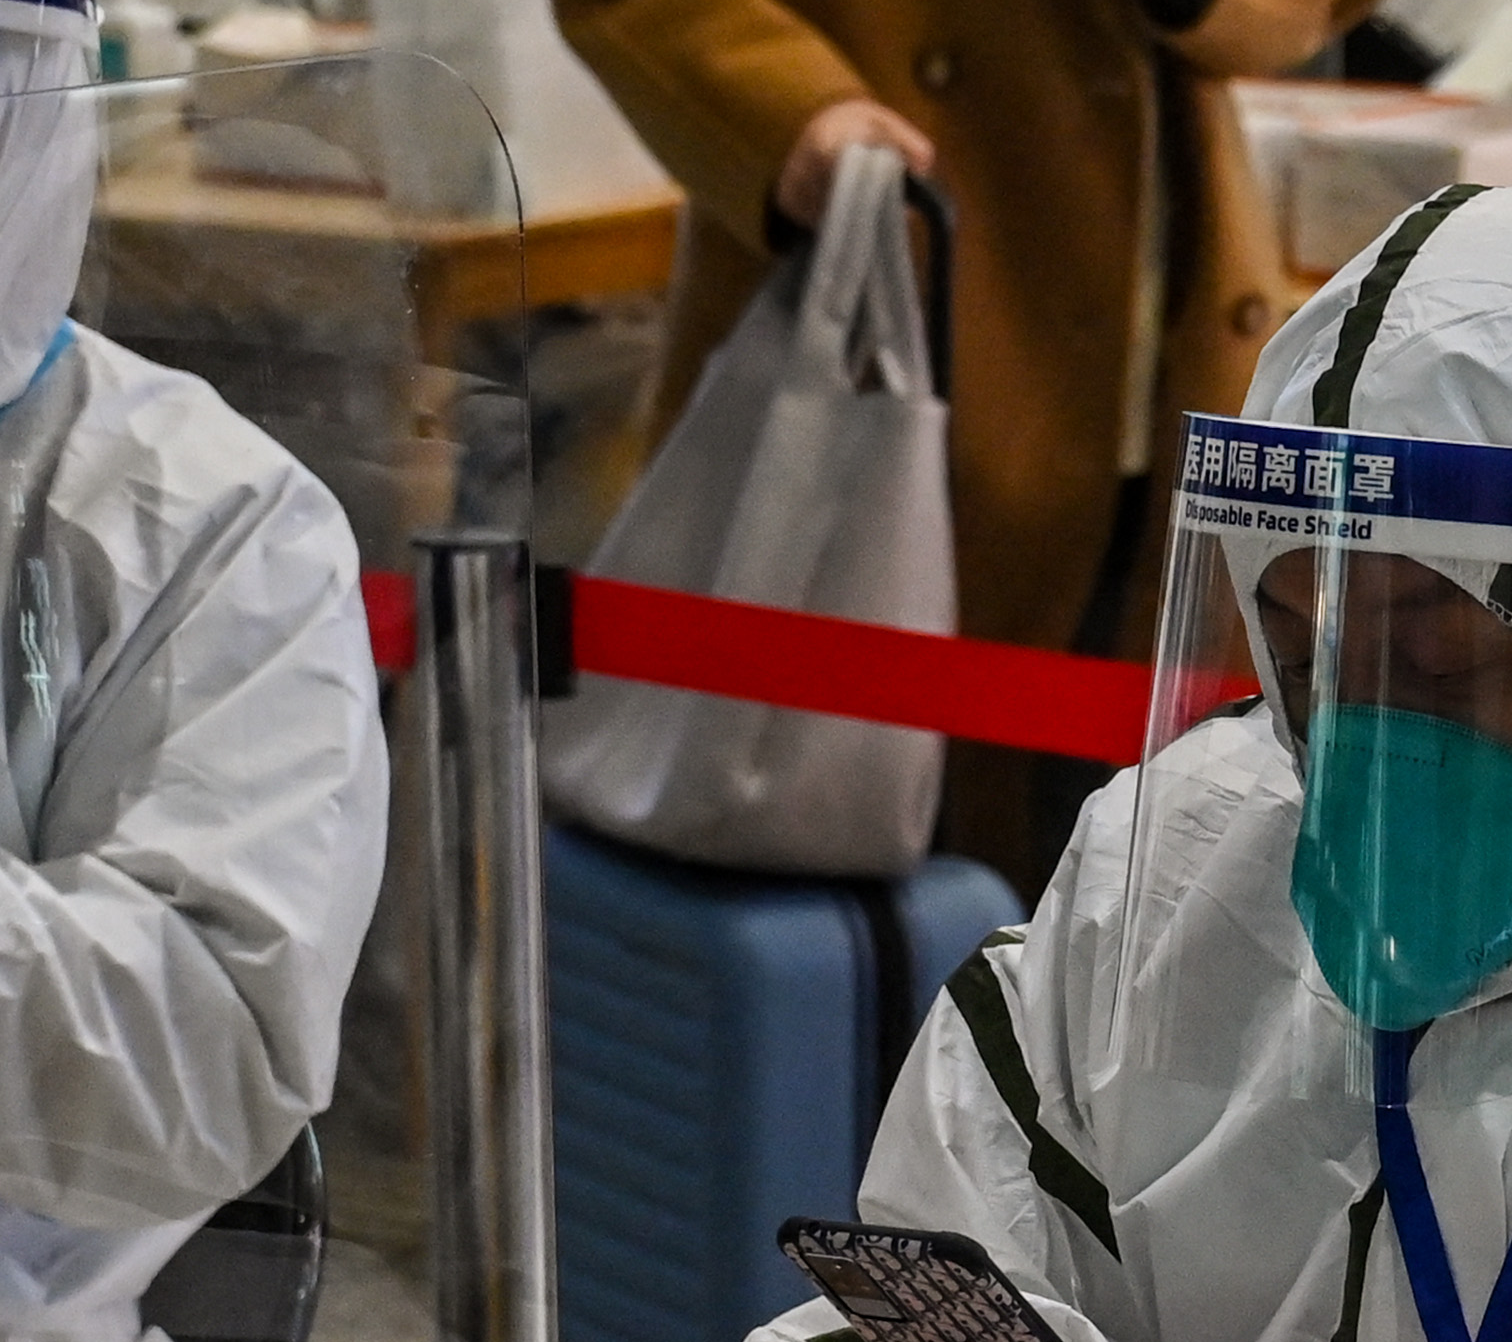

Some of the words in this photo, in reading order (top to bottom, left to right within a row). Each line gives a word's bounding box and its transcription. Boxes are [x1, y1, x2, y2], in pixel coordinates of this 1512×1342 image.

[1186, 434, 1395, 503] 医用隔离面罩
[1185, 500, 1252, 527] Disposable
[1257, 510, 1299, 533] Face
[1304, 515, 1373, 540] Shield
